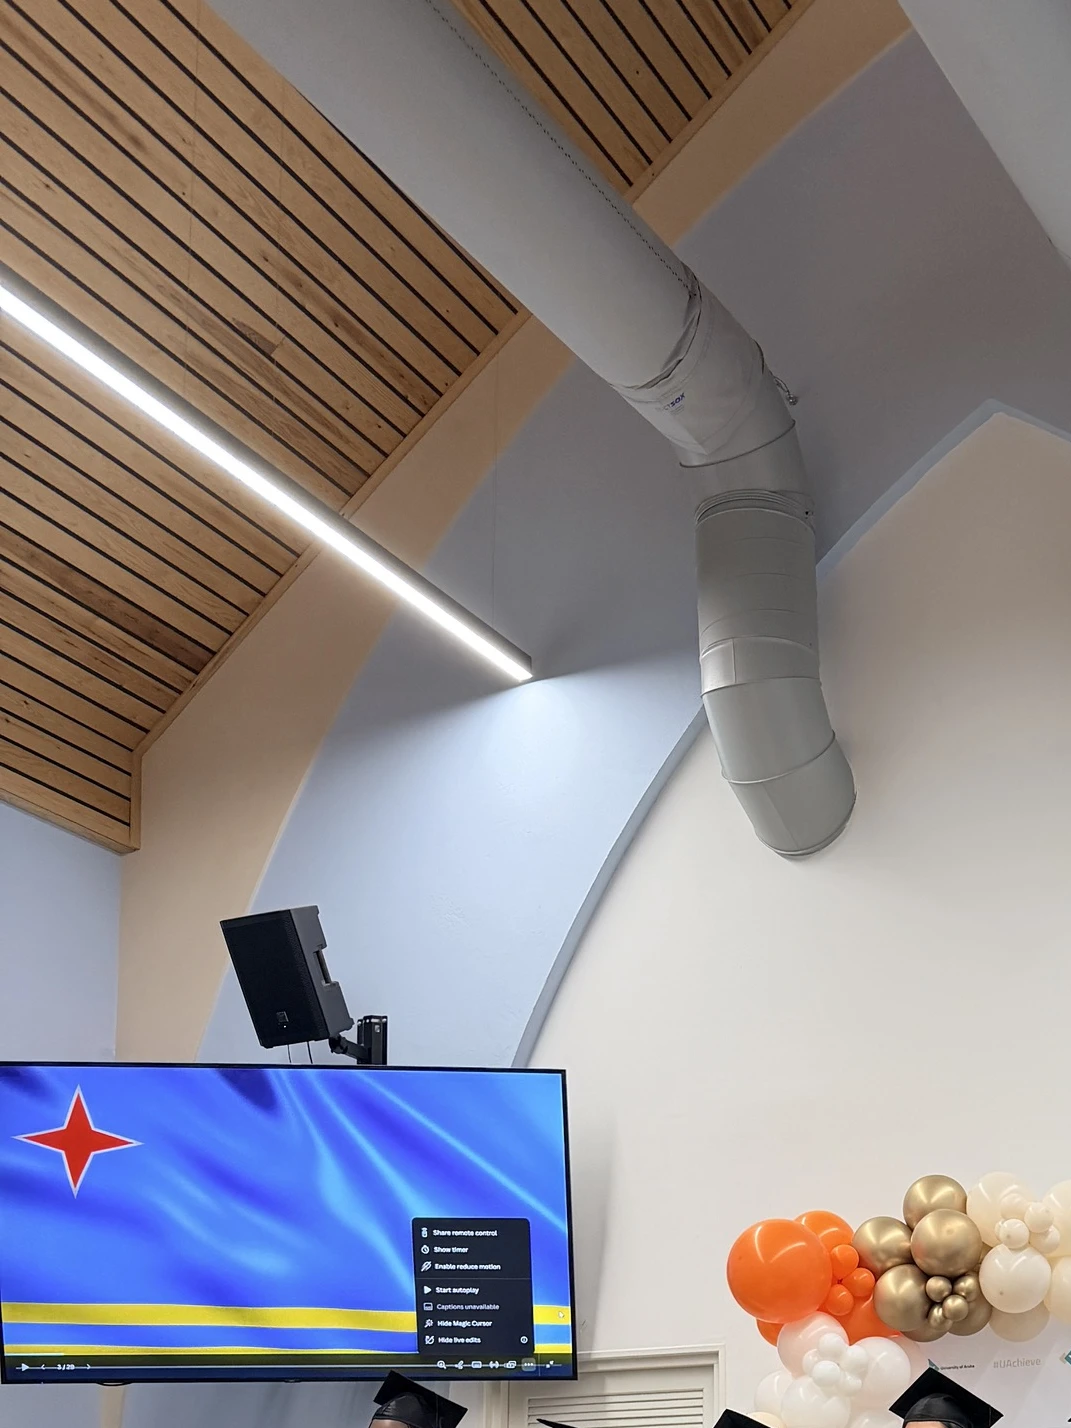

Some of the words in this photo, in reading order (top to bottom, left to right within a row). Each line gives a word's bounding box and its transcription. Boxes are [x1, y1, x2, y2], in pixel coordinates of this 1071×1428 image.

[474, 1229, 498, 1237] control
[452, 1286, 480, 1295] autoplay
[452, 1320, 471, 1328] Magic
[993, 1358, 1041, 1369] #UAchieve
